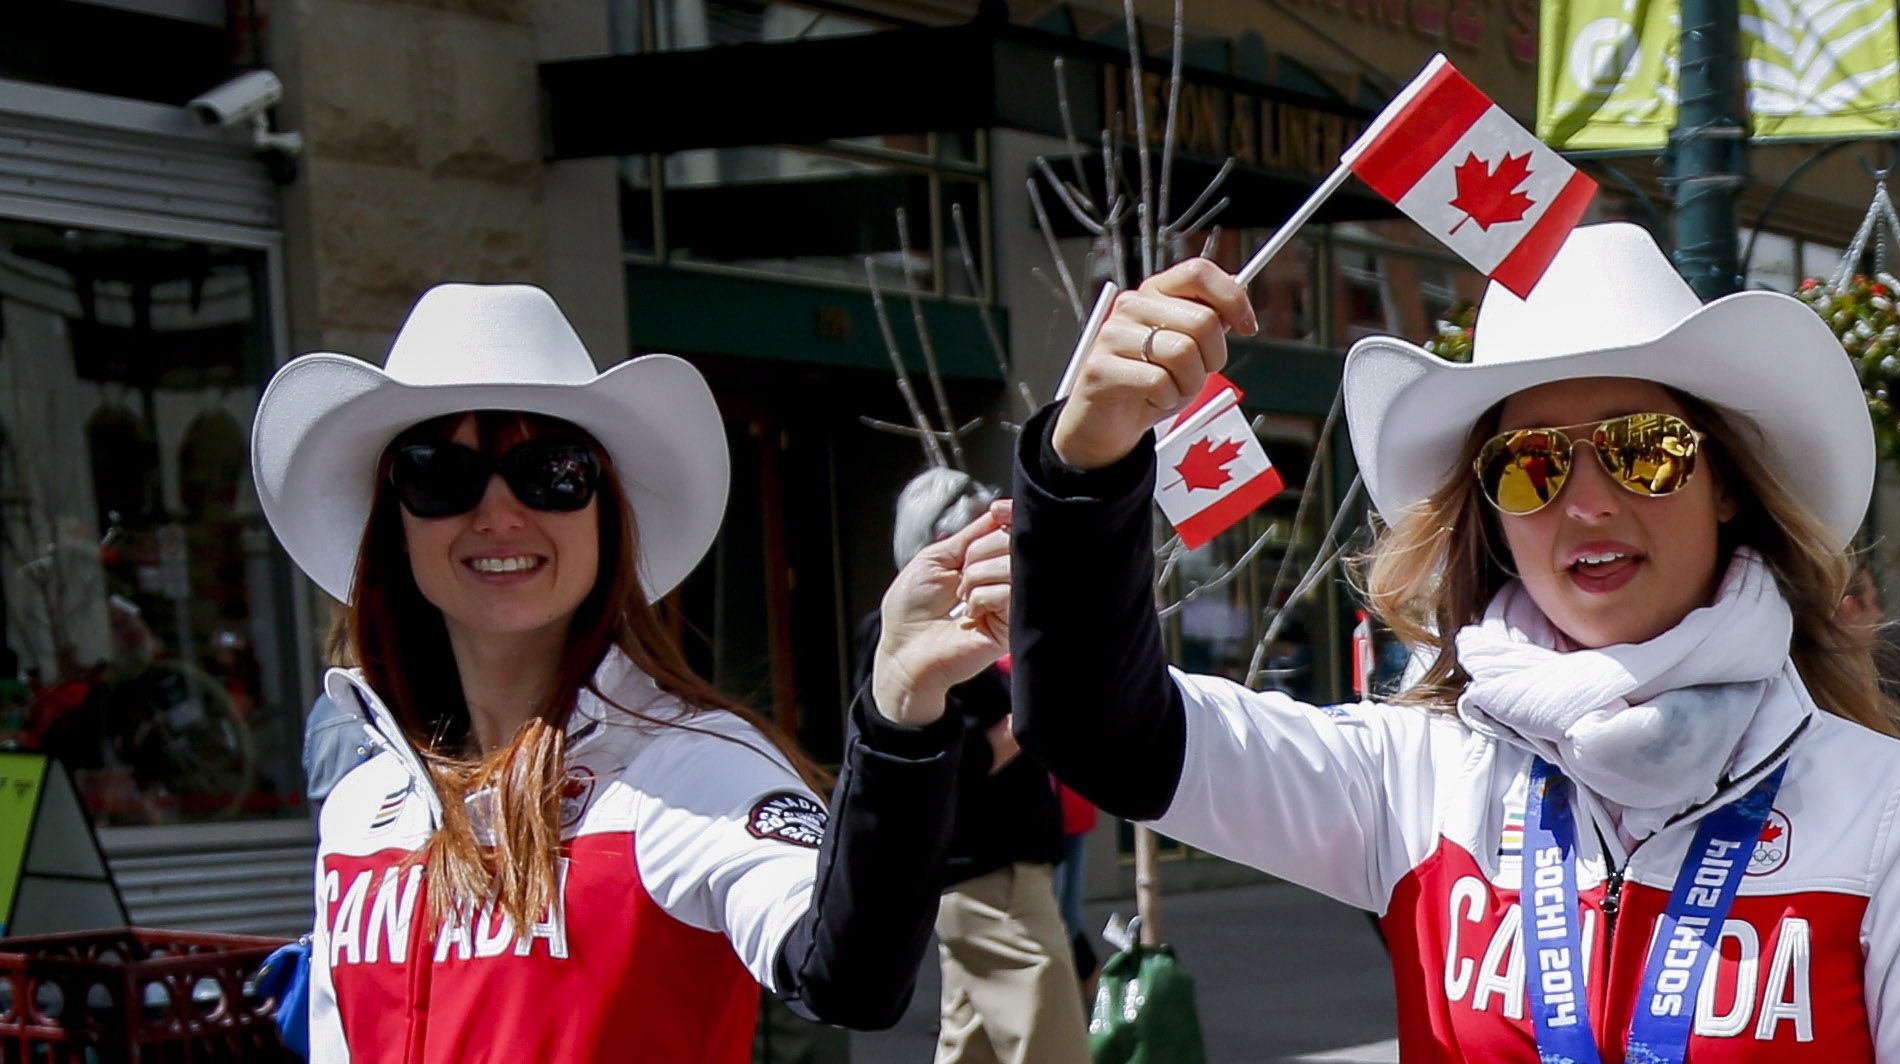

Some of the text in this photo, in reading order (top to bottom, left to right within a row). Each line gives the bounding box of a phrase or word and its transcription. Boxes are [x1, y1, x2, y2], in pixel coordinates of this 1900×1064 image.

[1444, 877, 1814, 1043] CADA
[1532, 846, 1578, 1028] SOCHI 2014
[1649, 838, 1743, 1018] SOCHI 2014
